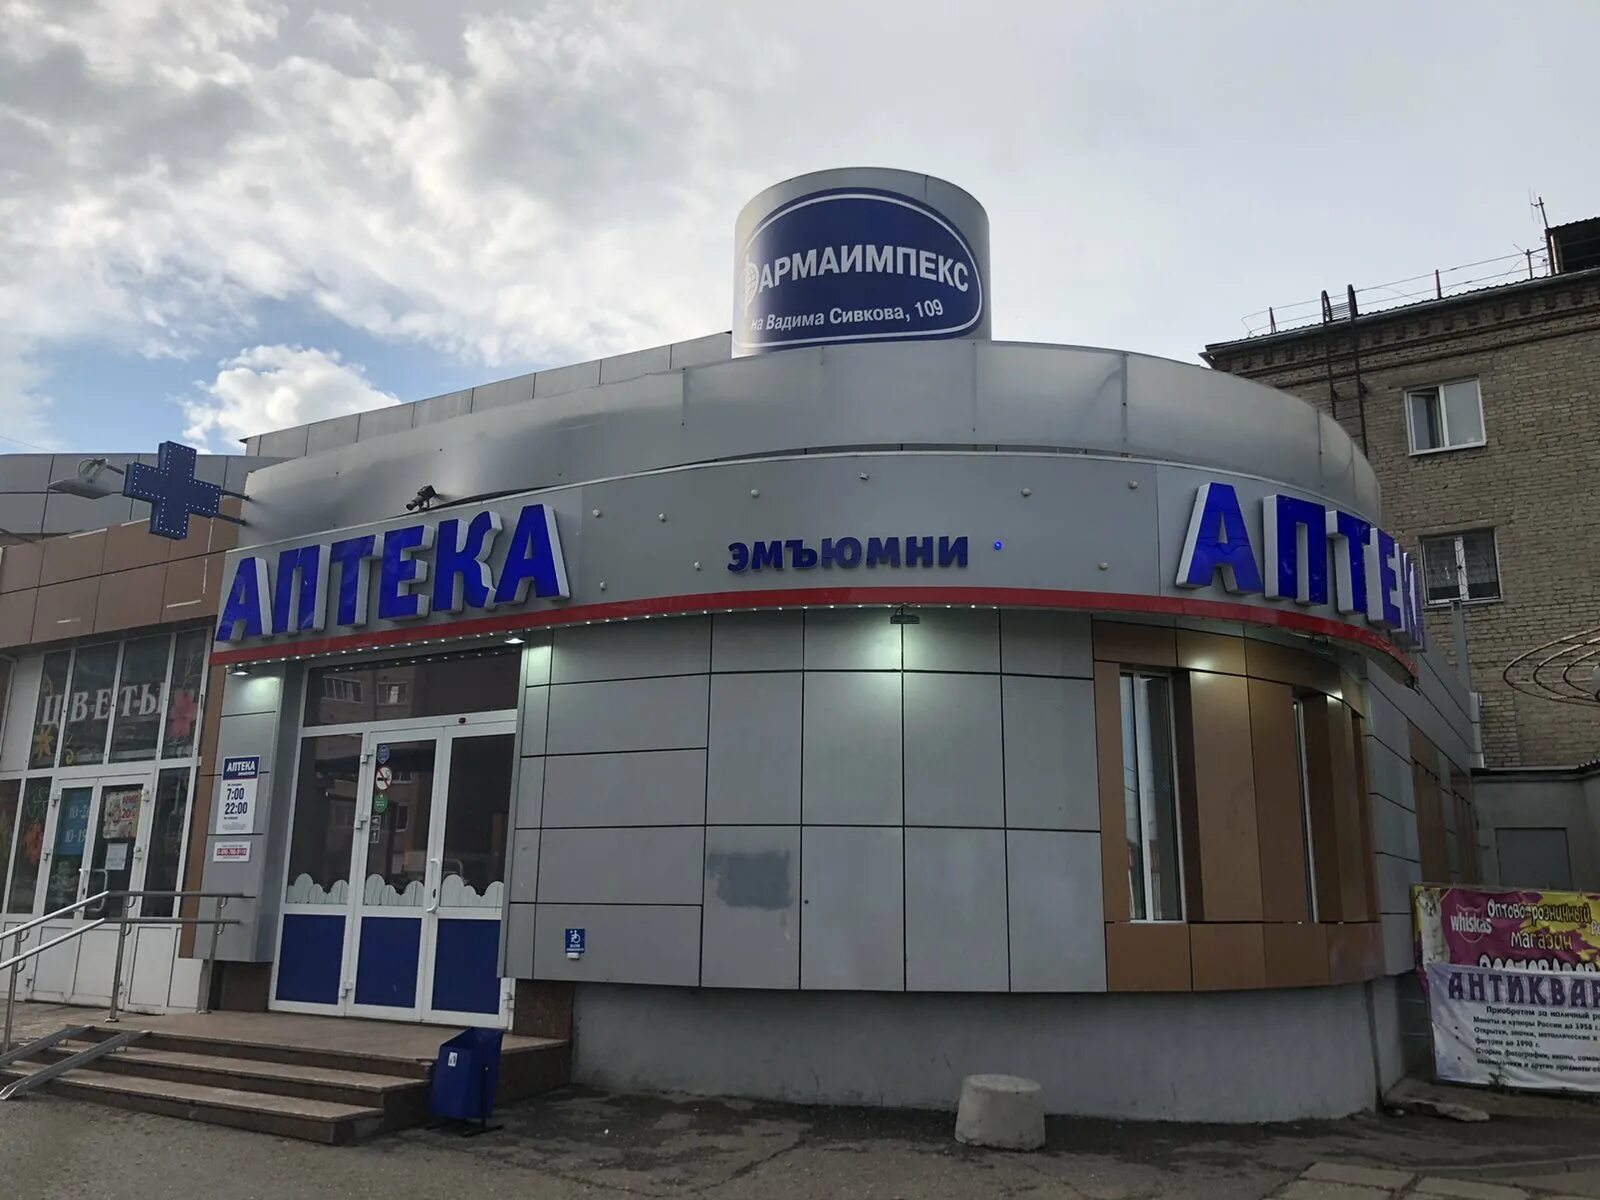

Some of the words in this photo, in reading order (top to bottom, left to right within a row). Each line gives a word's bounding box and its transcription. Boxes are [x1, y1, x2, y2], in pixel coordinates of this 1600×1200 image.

[766, 311, 825, 332] Вадима
[829, 306, 910, 324] Сивкова,
[914, 299, 944, 319] 109
[727, 535, 969, 573] ЭМЪЮМНИ
[215, 503, 571, 643] АПТЕКА
[226, 760, 256, 772] АПТЕКА
[226, 787, 245, 801] 7:00
[224, 801, 248, 815] 22:00
[1450, 912, 1493, 935] whiskas
[1487, 898, 1593, 926] Оптово-розничный
